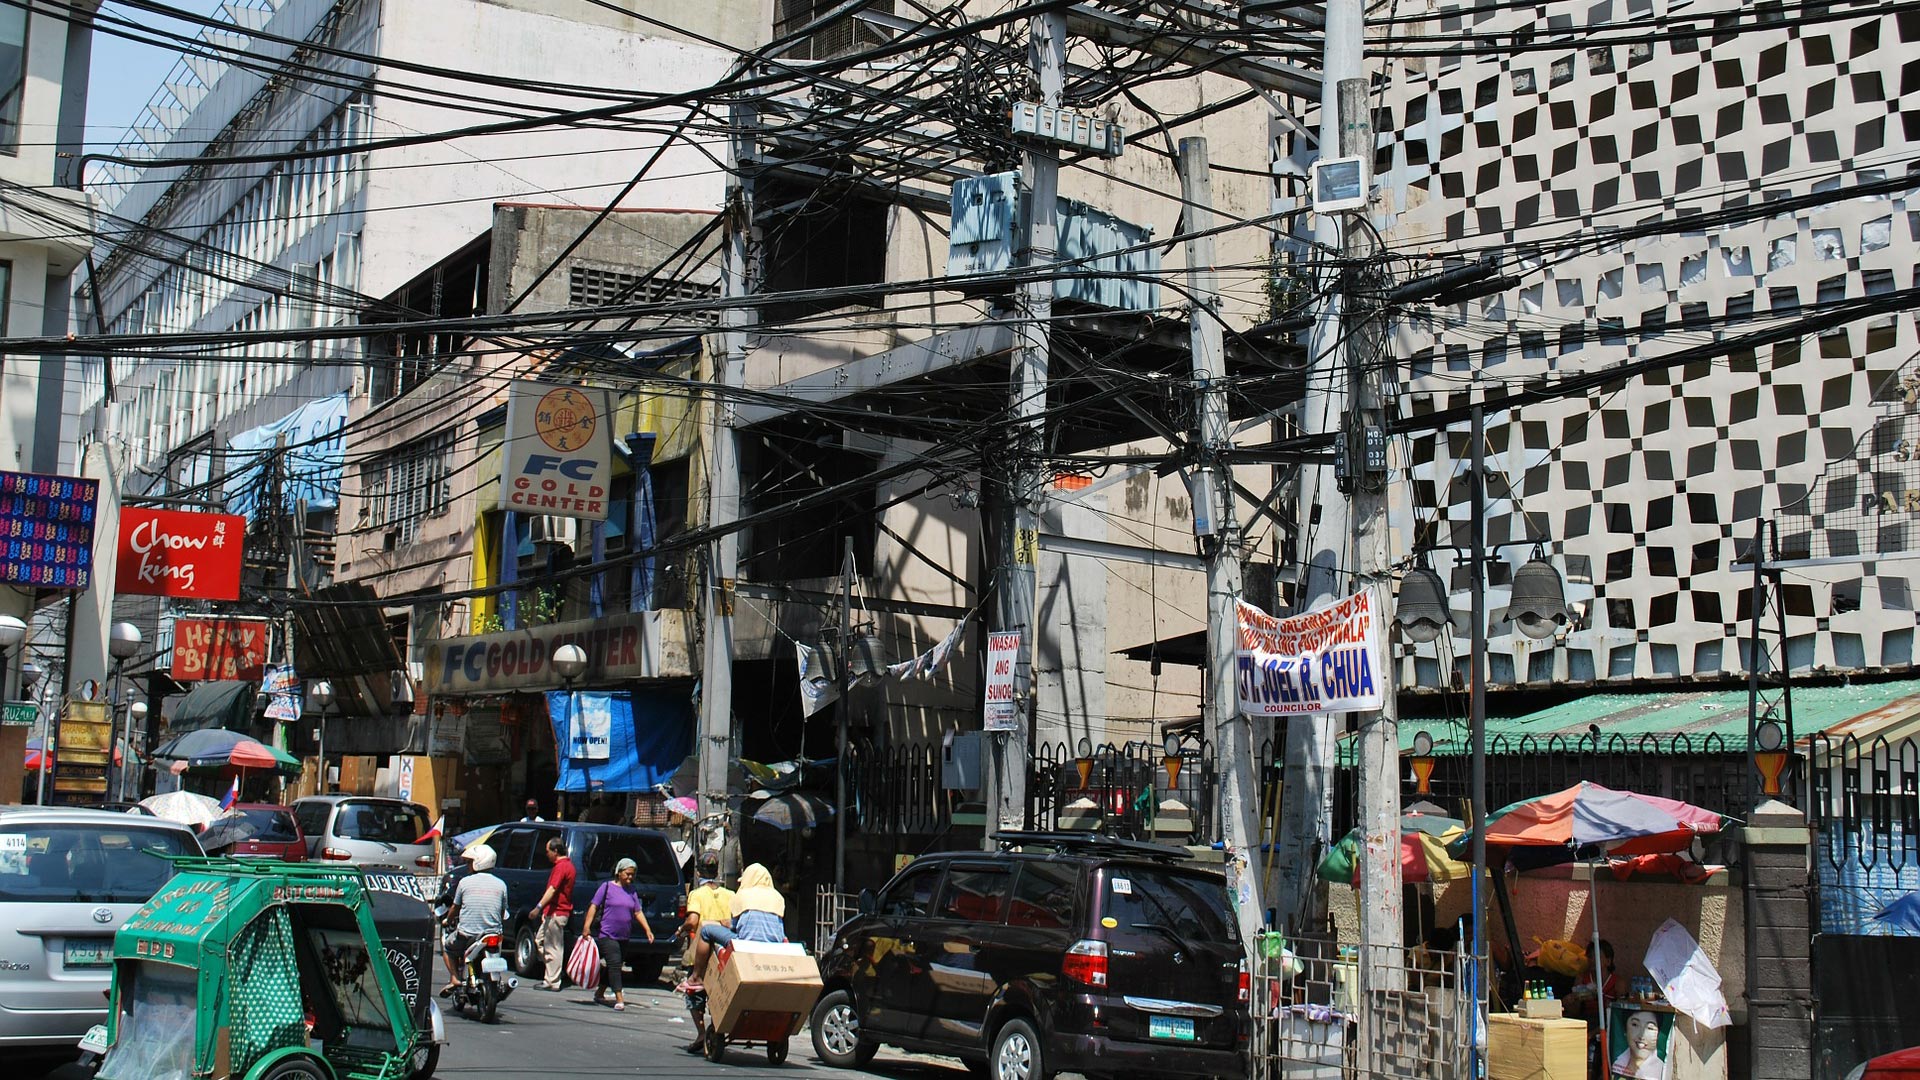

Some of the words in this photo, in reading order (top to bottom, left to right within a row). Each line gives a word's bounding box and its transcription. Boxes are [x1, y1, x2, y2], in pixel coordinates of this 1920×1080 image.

[522, 454, 599, 481] FC
[514, 477, 604, 498] GOLD
[511, 491, 602, 513] CENTER
[131, 519, 207, 553] Chow
[1019, 529, 1034, 541] 38
[138, 552, 194, 589] king
[1354, 592, 1368, 613] SA
[185, 624, 255, 648] Happy
[988, 635, 1020, 652] IWASAN
[443, 641, 486, 685] FC
[486, 637, 545, 678] GOLD
[994, 660, 1009, 675] ANG
[1300, 658, 1320, 701] R.
[1322, 648, 1374, 700] CHUA
[987, 683, 1012, 700] SUNOG
[1264, 702, 1322, 713] COUNCILOR
[572, 736, 587, 745] NOW
[589, 736, 608, 745] OPEN!
[6, 837, 26, 848] 4114
